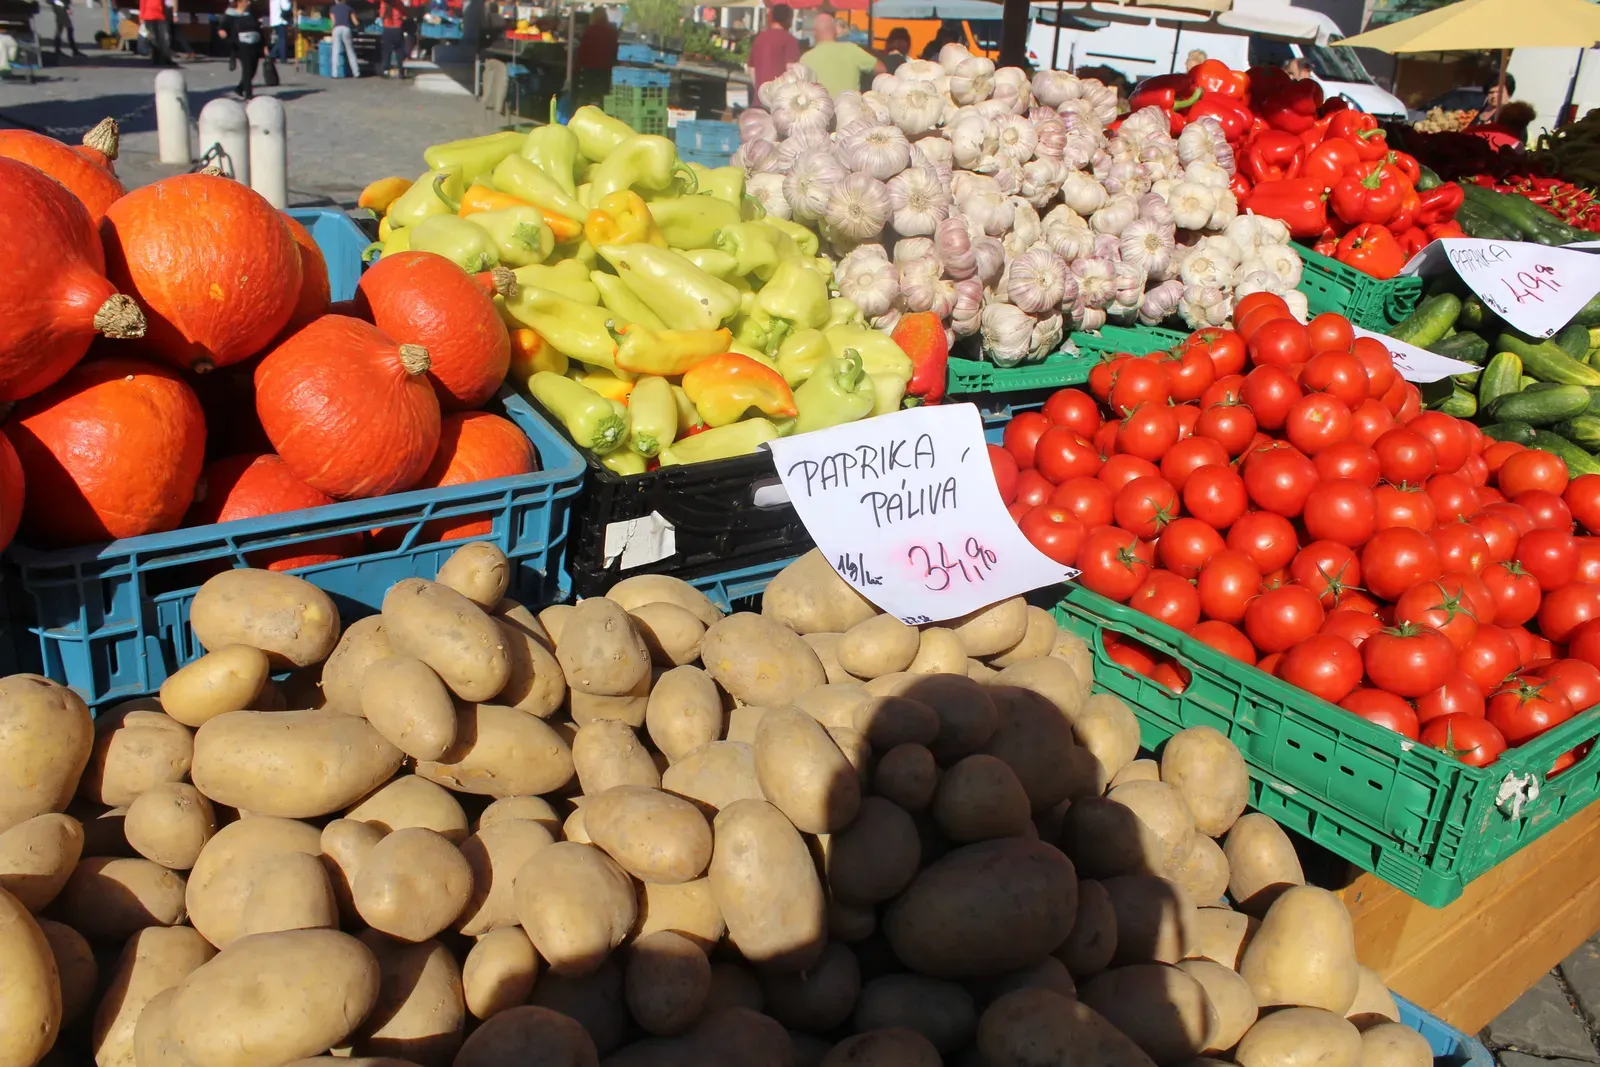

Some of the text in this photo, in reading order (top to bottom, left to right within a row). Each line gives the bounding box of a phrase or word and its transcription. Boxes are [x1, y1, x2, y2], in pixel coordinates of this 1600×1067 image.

[1449, 244, 1512, 273] PAPRIKA
[787, 433, 935, 497] PAPRIKA
[860, 476, 957, 528] PÁLIVA
[907, 536, 997, 591] 34,90
